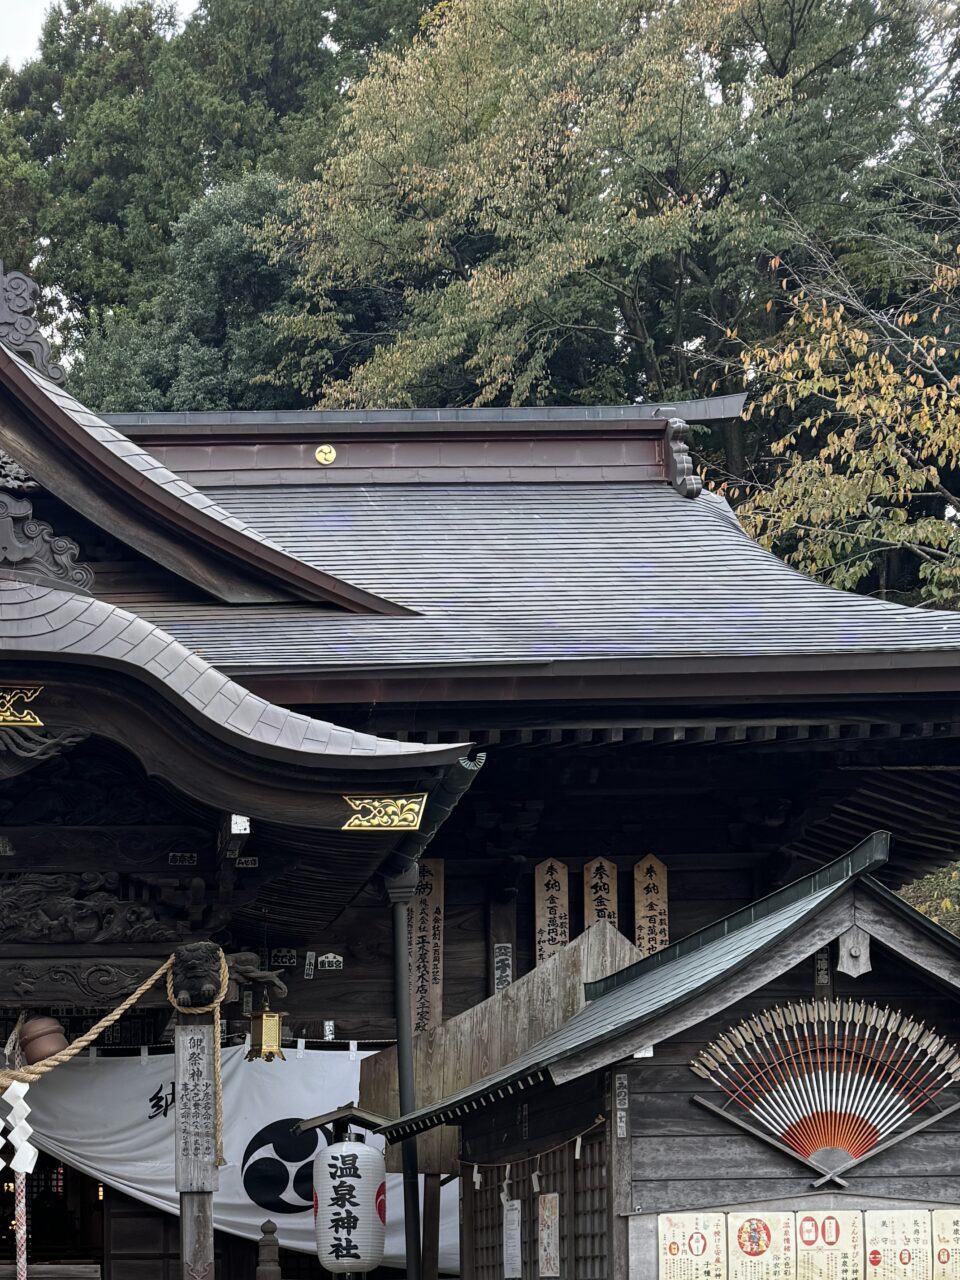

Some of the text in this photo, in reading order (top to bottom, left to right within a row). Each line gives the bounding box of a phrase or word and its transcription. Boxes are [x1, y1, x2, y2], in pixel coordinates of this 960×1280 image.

[415, 864, 433, 896] 奉納
[544, 862, 561, 945] 奉納 金百萬円也
[590, 862, 610, 922] 奉納 金百
[643, 864, 660, 955] 奉納 金百萬円也
[187, 1036, 204, 1081] 御祭神
[328, 1153, 362, 1260] 温泉神社
